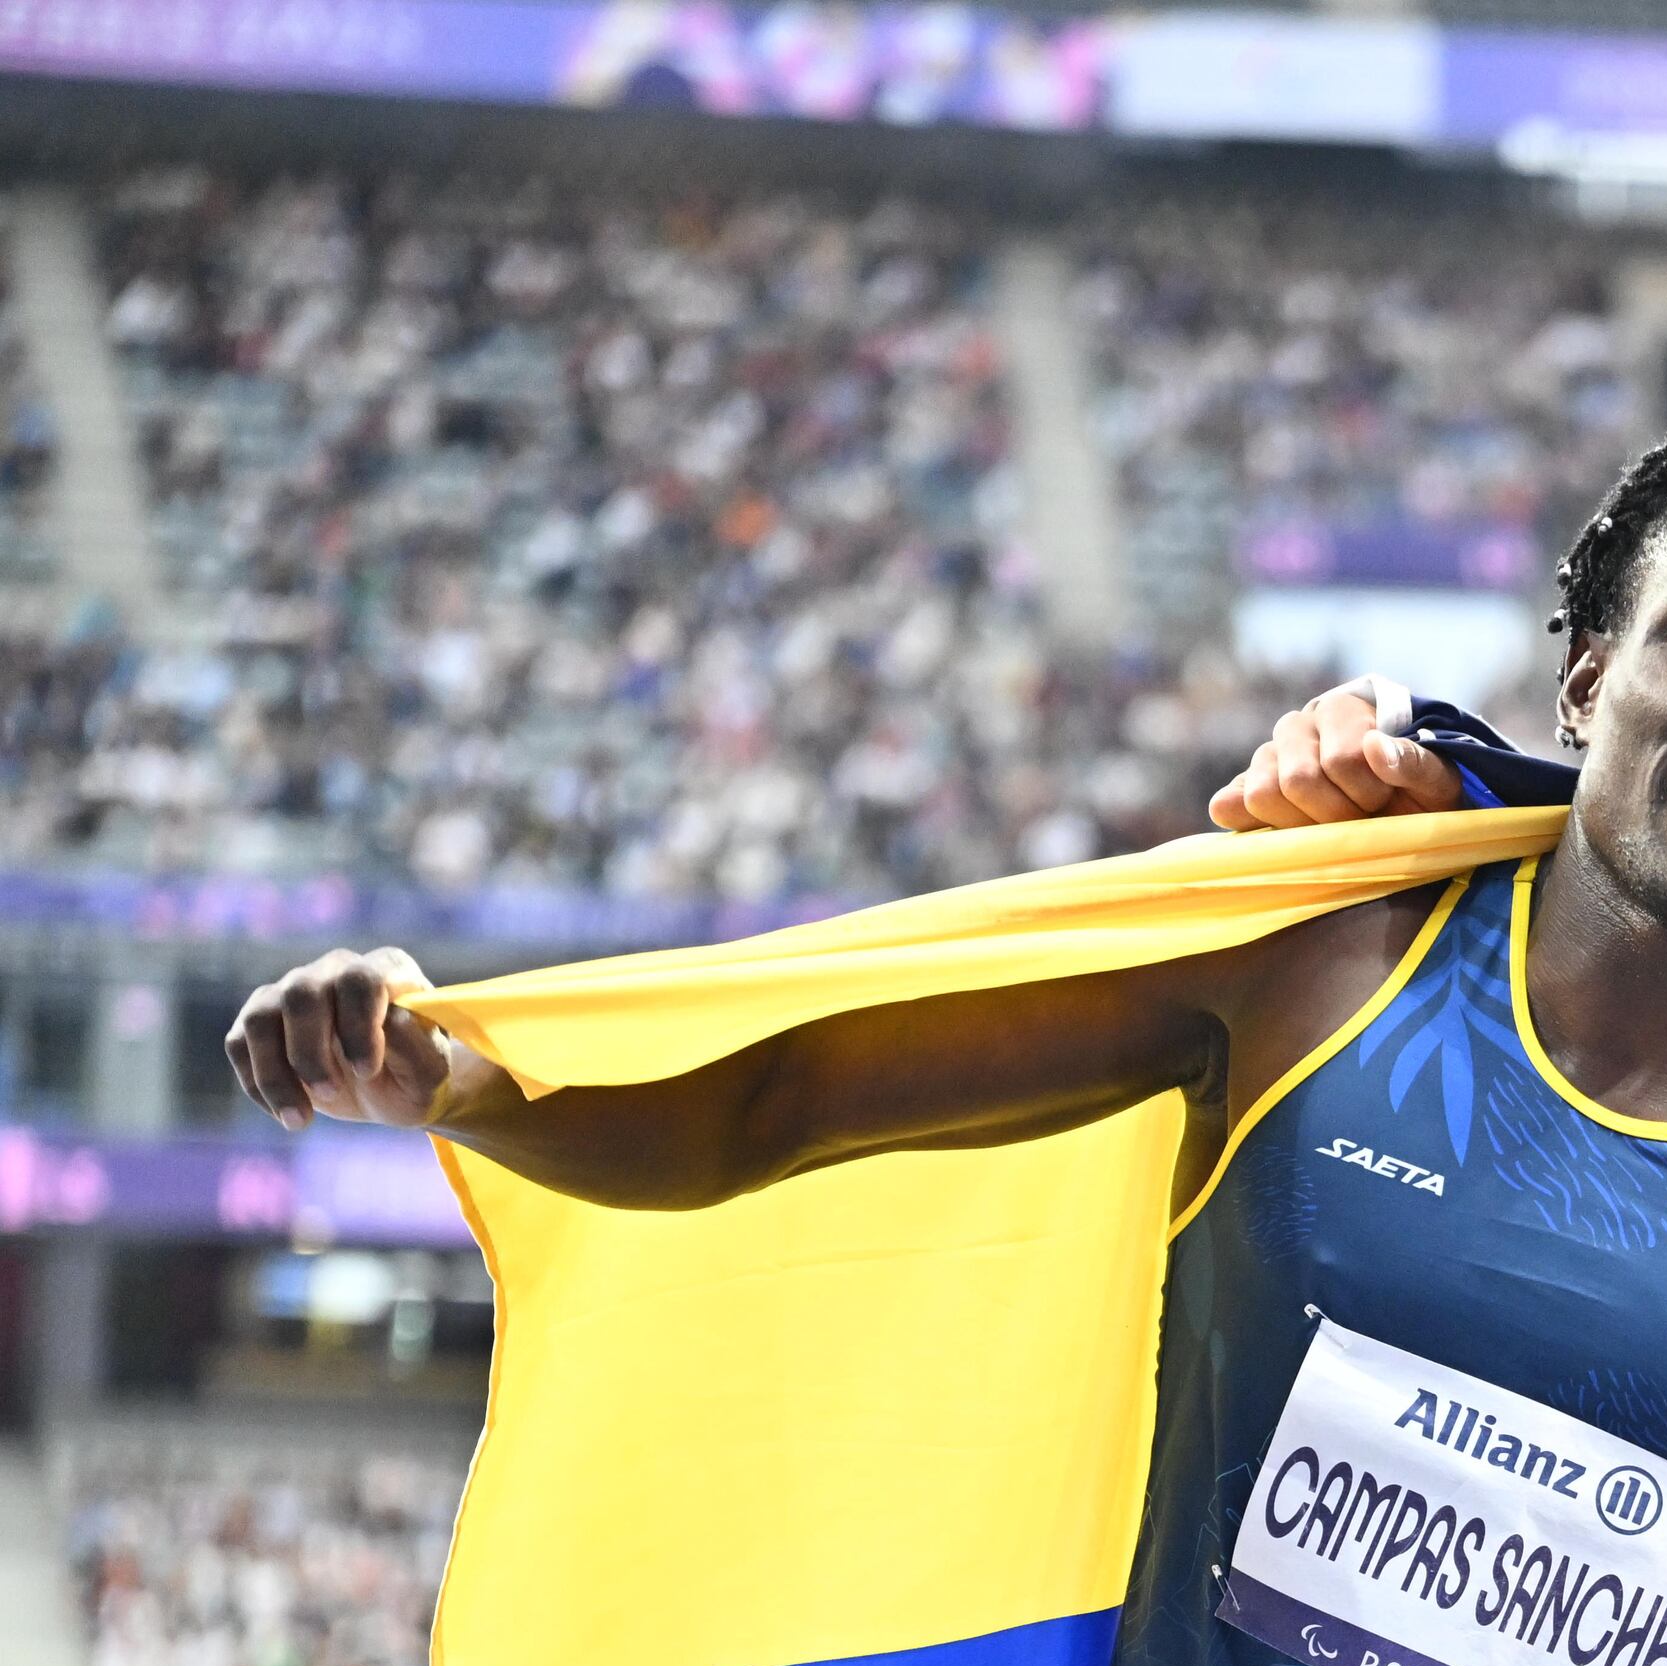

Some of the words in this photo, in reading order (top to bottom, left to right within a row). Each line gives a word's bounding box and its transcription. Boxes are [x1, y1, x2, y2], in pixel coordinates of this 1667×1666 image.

[1315, 1137, 1445, 1198] SAETA
[1394, 1387, 1587, 1499] Allianz
[1264, 1446, 1487, 1611] CAMPAS
